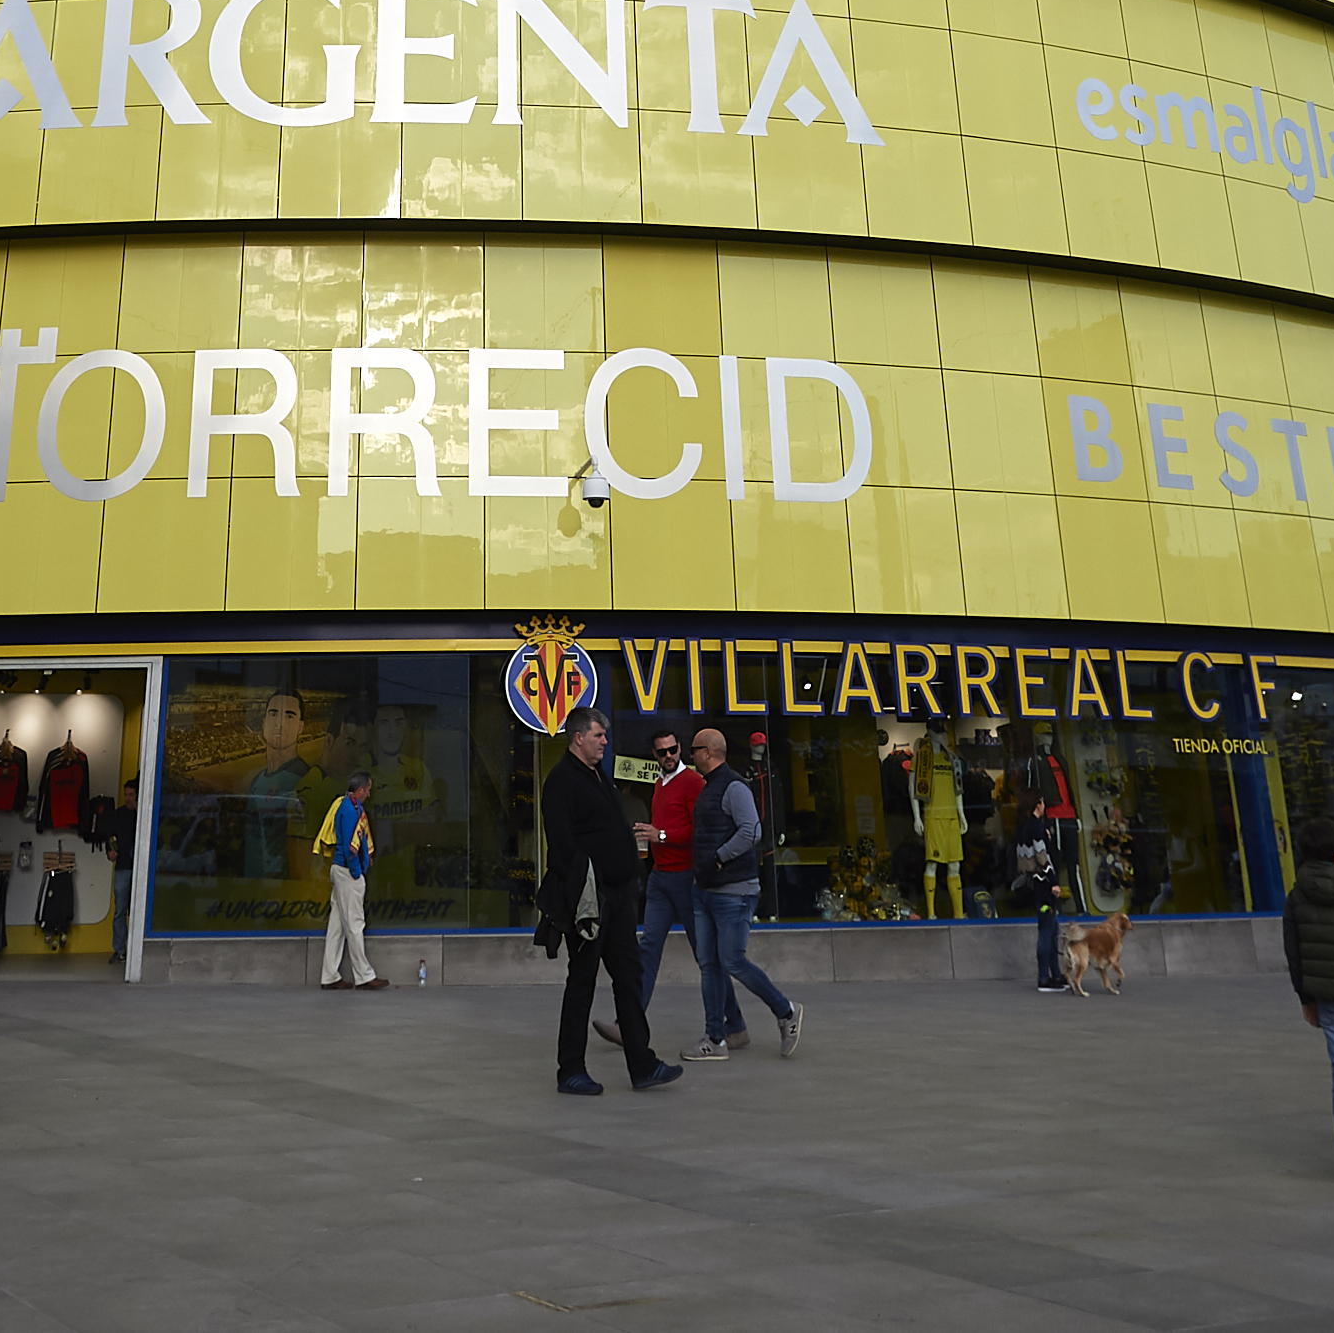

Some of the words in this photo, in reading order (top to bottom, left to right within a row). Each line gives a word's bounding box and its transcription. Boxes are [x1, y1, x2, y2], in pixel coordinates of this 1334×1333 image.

[619, 636, 1156, 722] VILLARREAL
[1178, 649, 1223, 724] C
[1245, 651, 1279, 724] F
[1172, 737, 1221, 755] TIENDA
[1221, 738, 1269, 756] OFICIAL
[636, 770, 650, 780] SE
[373, 798, 424, 818] PAMESA
